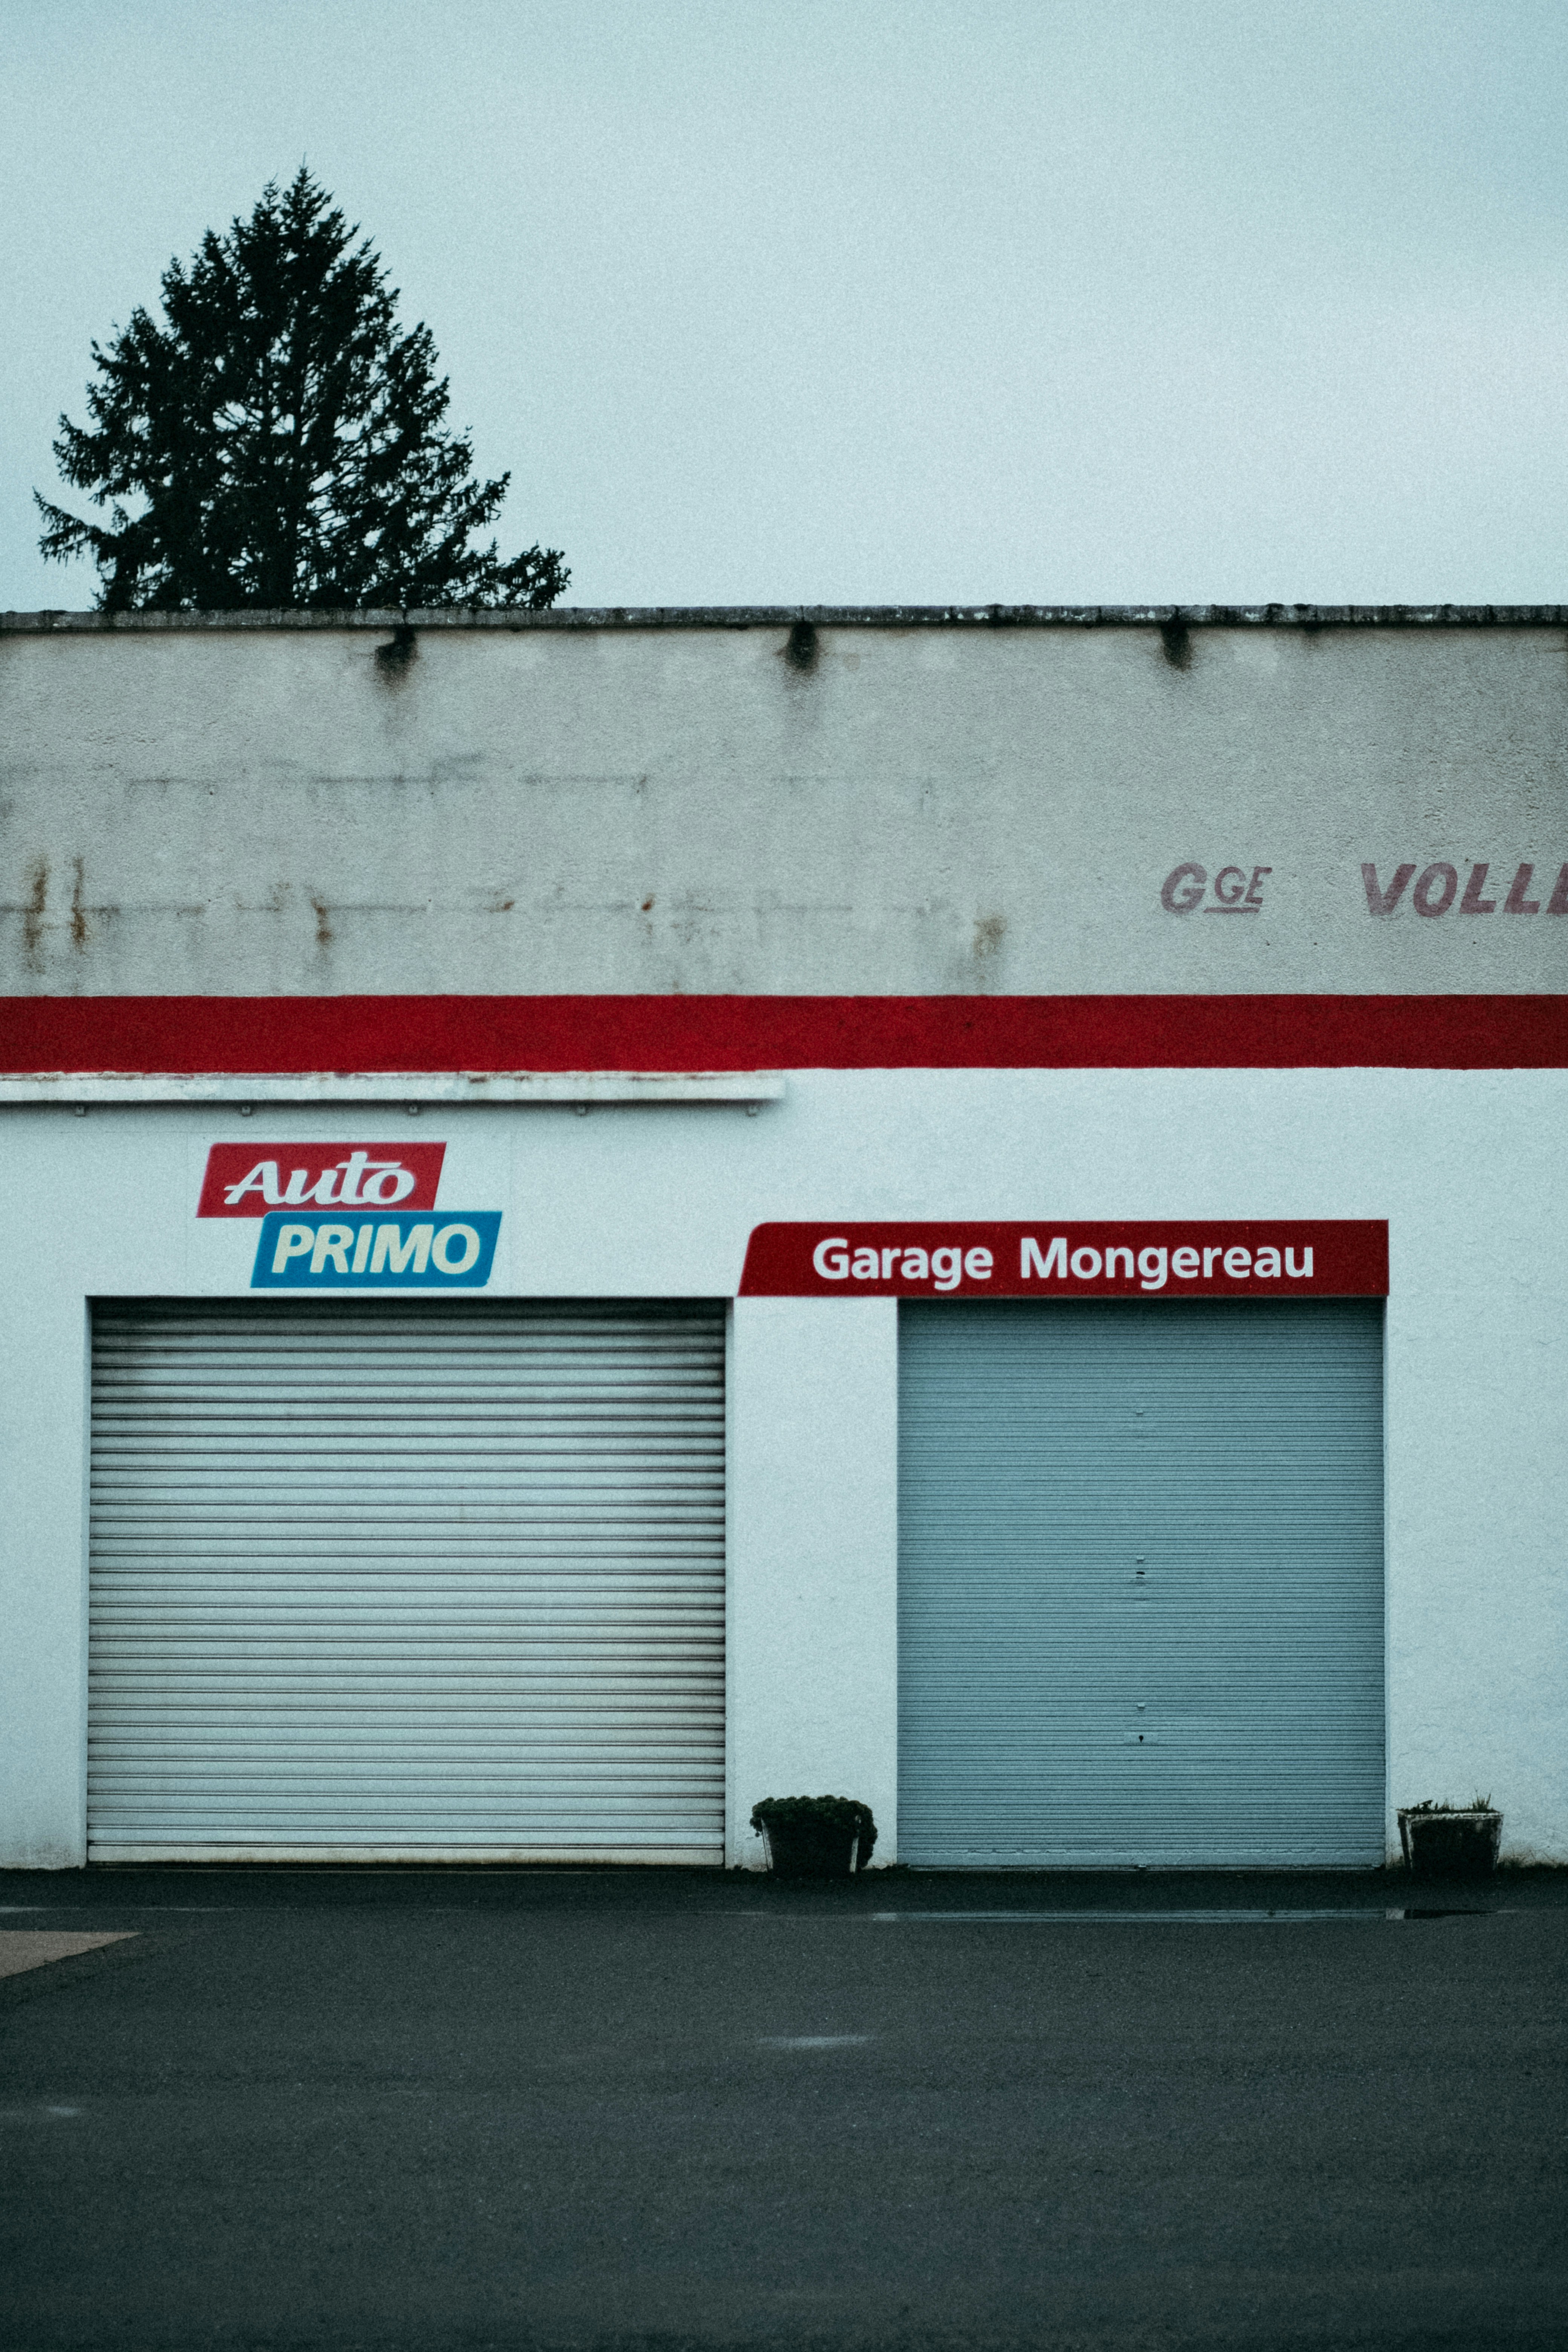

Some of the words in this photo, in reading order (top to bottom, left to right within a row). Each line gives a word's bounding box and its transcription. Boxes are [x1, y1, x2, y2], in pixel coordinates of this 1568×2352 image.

[224, 1151, 415, 1205] Auto
[272, 1223, 480, 1274] PRIMO
[812, 1237, 994, 1291] Garage
[1020, 1237, 1314, 1290] Mongereau
